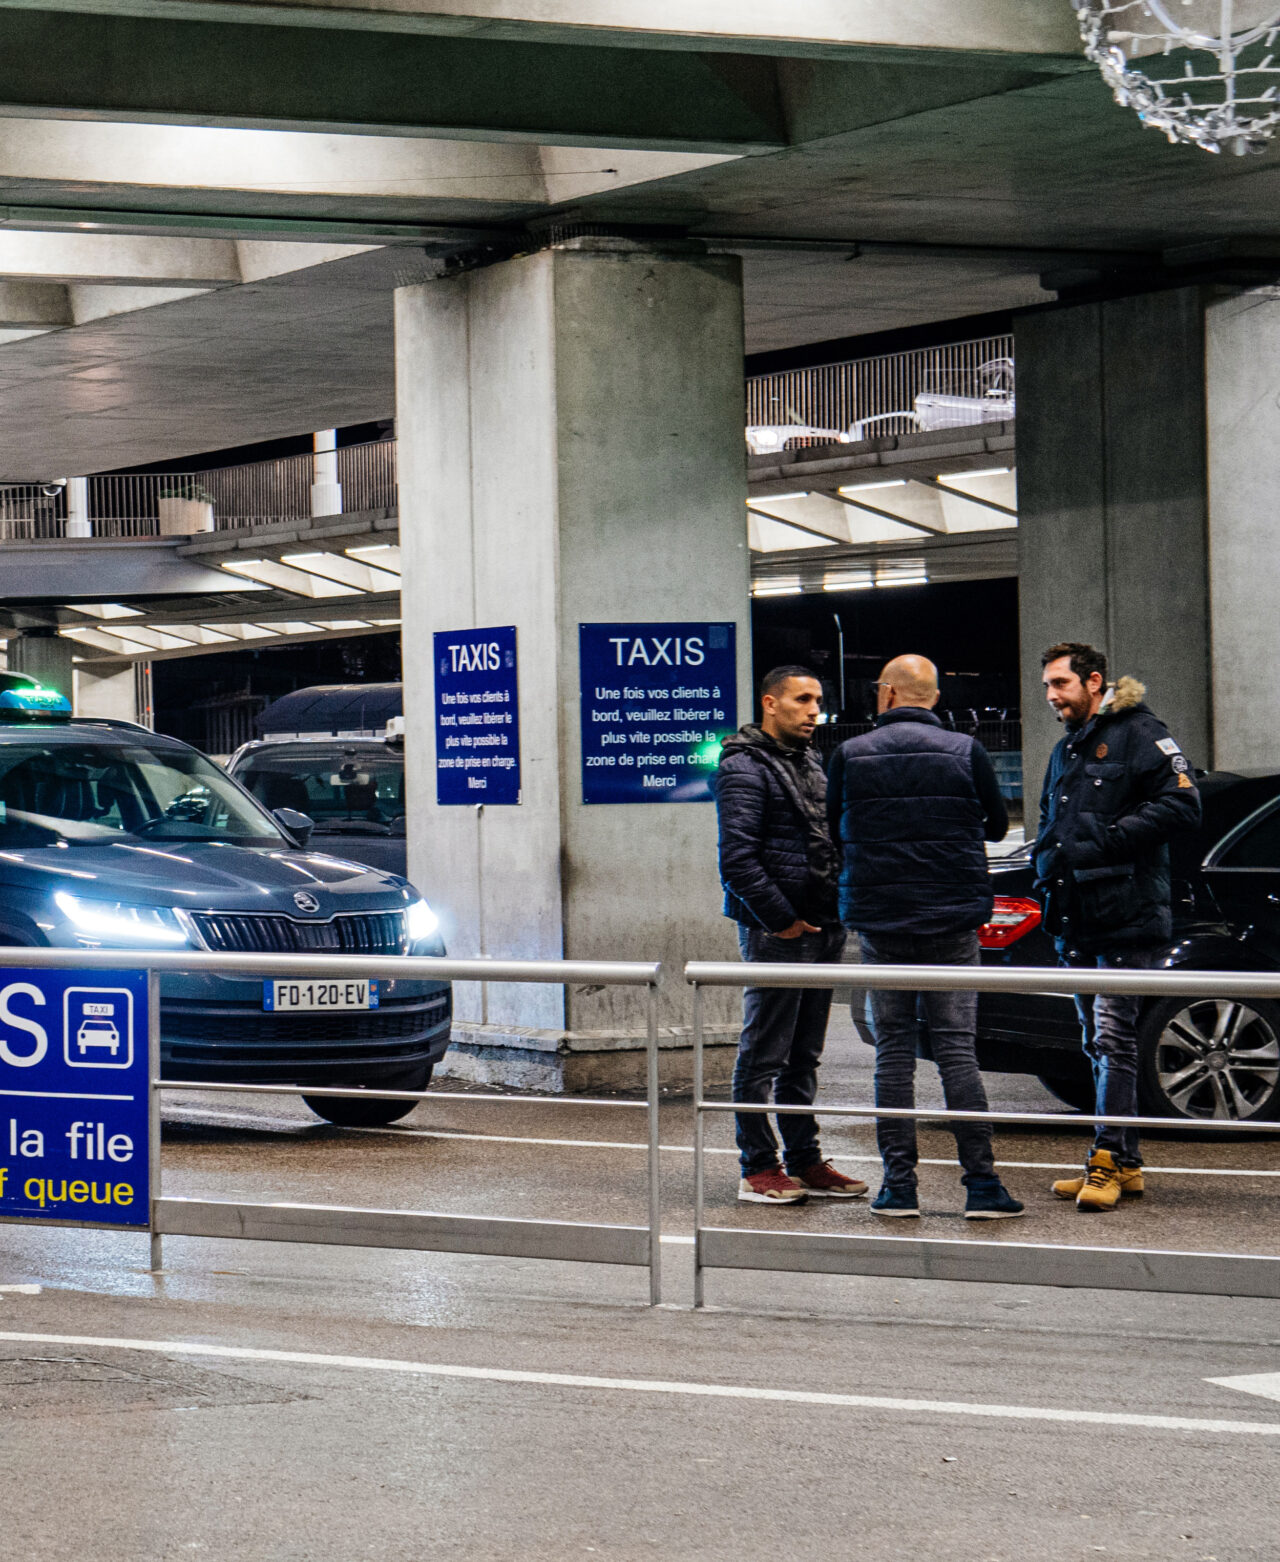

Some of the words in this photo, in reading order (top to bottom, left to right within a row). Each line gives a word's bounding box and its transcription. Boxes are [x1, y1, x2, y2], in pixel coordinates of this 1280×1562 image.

[448, 642, 500, 672] TAXIS
[609, 637, 705, 666] TAXIS
[442, 693, 456, 704] Une
[456, 692, 469, 704] fois
[469, 694, 482, 703] vos
[482, 691, 503, 702] clients
[595, 687, 620, 699] Une
[623, 687, 645, 699] fois
[647, 689, 669, 699] vos
[672, 686, 710, 698] clients
[712, 685, 721, 698] à
[440, 714, 458, 727] bord,
[458, 713, 483, 725] veuillez
[505, 712, 512, 723] le
[592, 709, 623, 723] bord,
[626, 708, 671, 720] veuillez
[673, 707, 711, 720] libérer
[714, 708, 725, 720] le
[445, 735, 460, 749] plus
[460, 735, 472, 746] vite
[473, 733, 500, 748] possible
[501, 733, 508, 745] la
[601, 731, 627, 746] plus
[629, 730, 651, 743] vite
[653, 730, 703, 746] possible
[705, 730, 716, 742] la
[438, 758, 454, 768] zone
[455, 756, 464, 767] de
[465, 755, 481, 770] prise
[482, 758, 491, 767] en
[586, 756, 616, 766] zone
[619, 753, 634, 765] de
[637, 752, 666, 768] prise
[669, 755, 685, 764] en
[468, 777, 487, 789] Merci
[643, 774, 677, 787] Merci
[278, 984, 365, 1006] FD-120-EV
[89, 1005, 109, 1014] TAXI
[9, 1118, 45, 1158] la
[65, 1121, 134, 1163] file
[24, 1178, 134, 1207] queue
